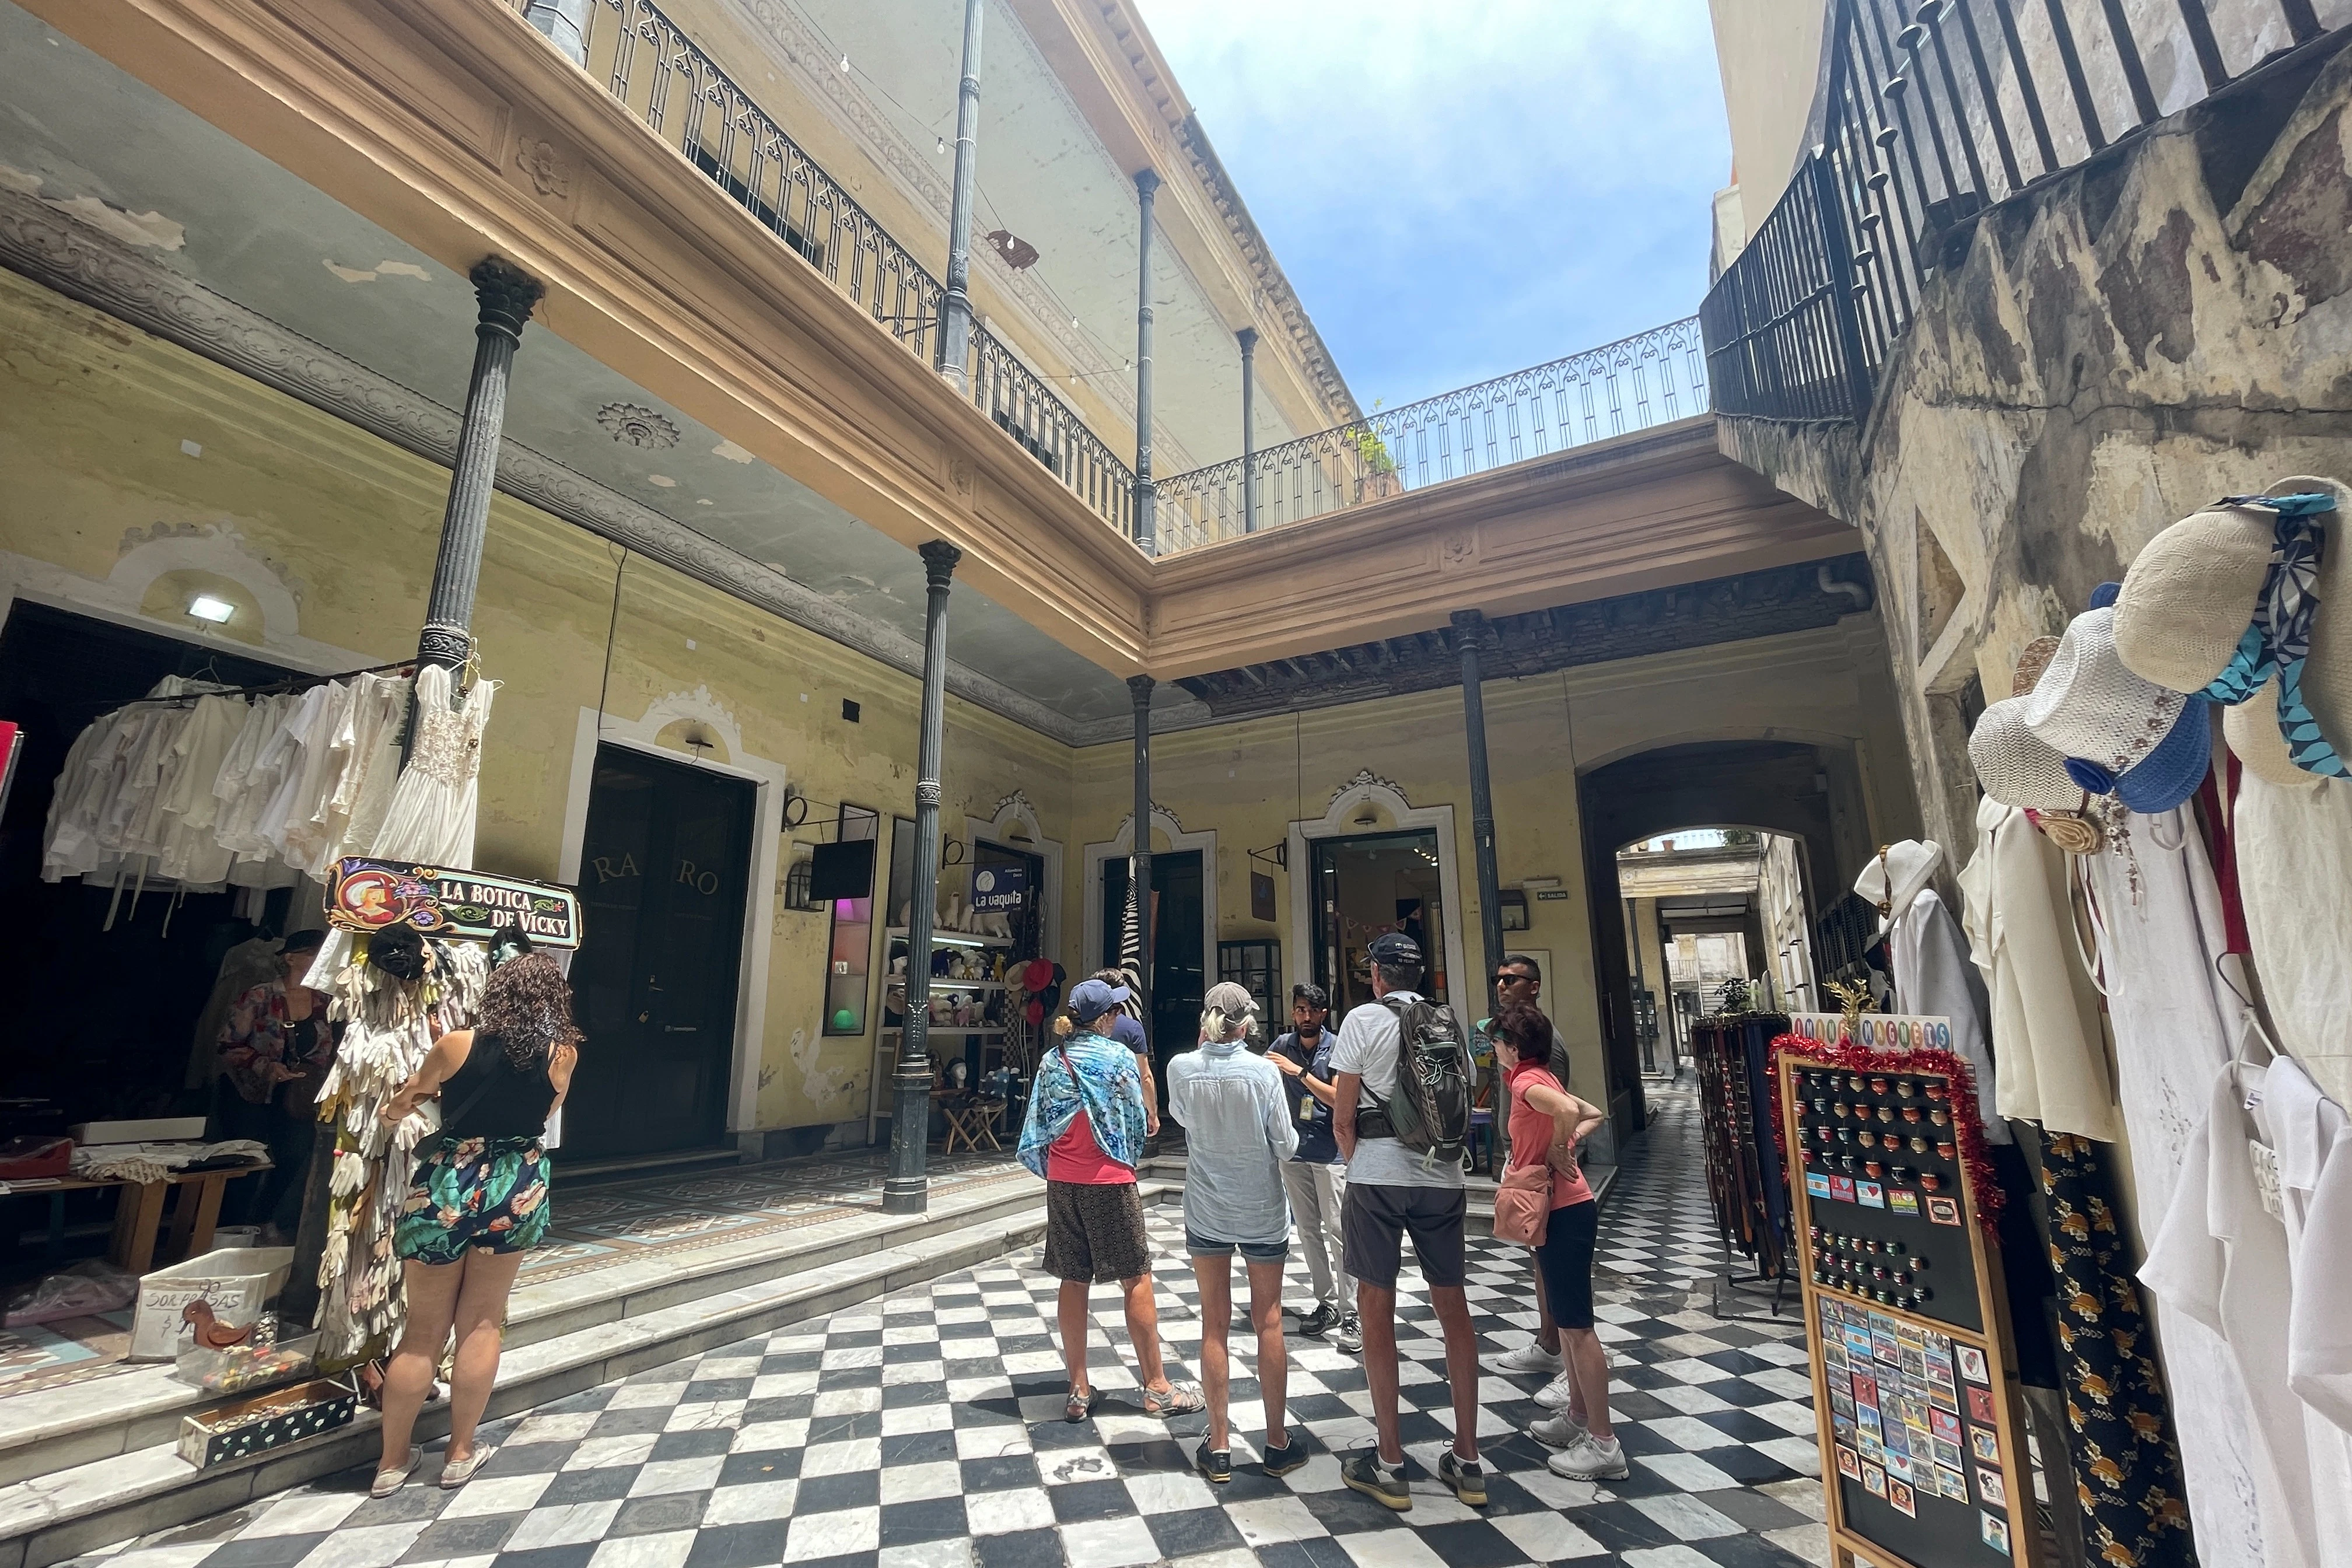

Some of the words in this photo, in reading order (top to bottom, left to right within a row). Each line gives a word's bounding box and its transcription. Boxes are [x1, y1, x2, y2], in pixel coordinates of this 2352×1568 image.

[592, 852, 640, 884] RA
[676, 859, 719, 895] RO
[439, 880, 465, 902] LA
[471, 884, 531, 911] BOTICA
[516, 910, 568, 936] VICKY
[1796, 1019, 1858, 1042] IMANE
[1864, 1021, 1948, 1046] MAGNETS
[146, 1292, 241, 1308] SORPRSAS
